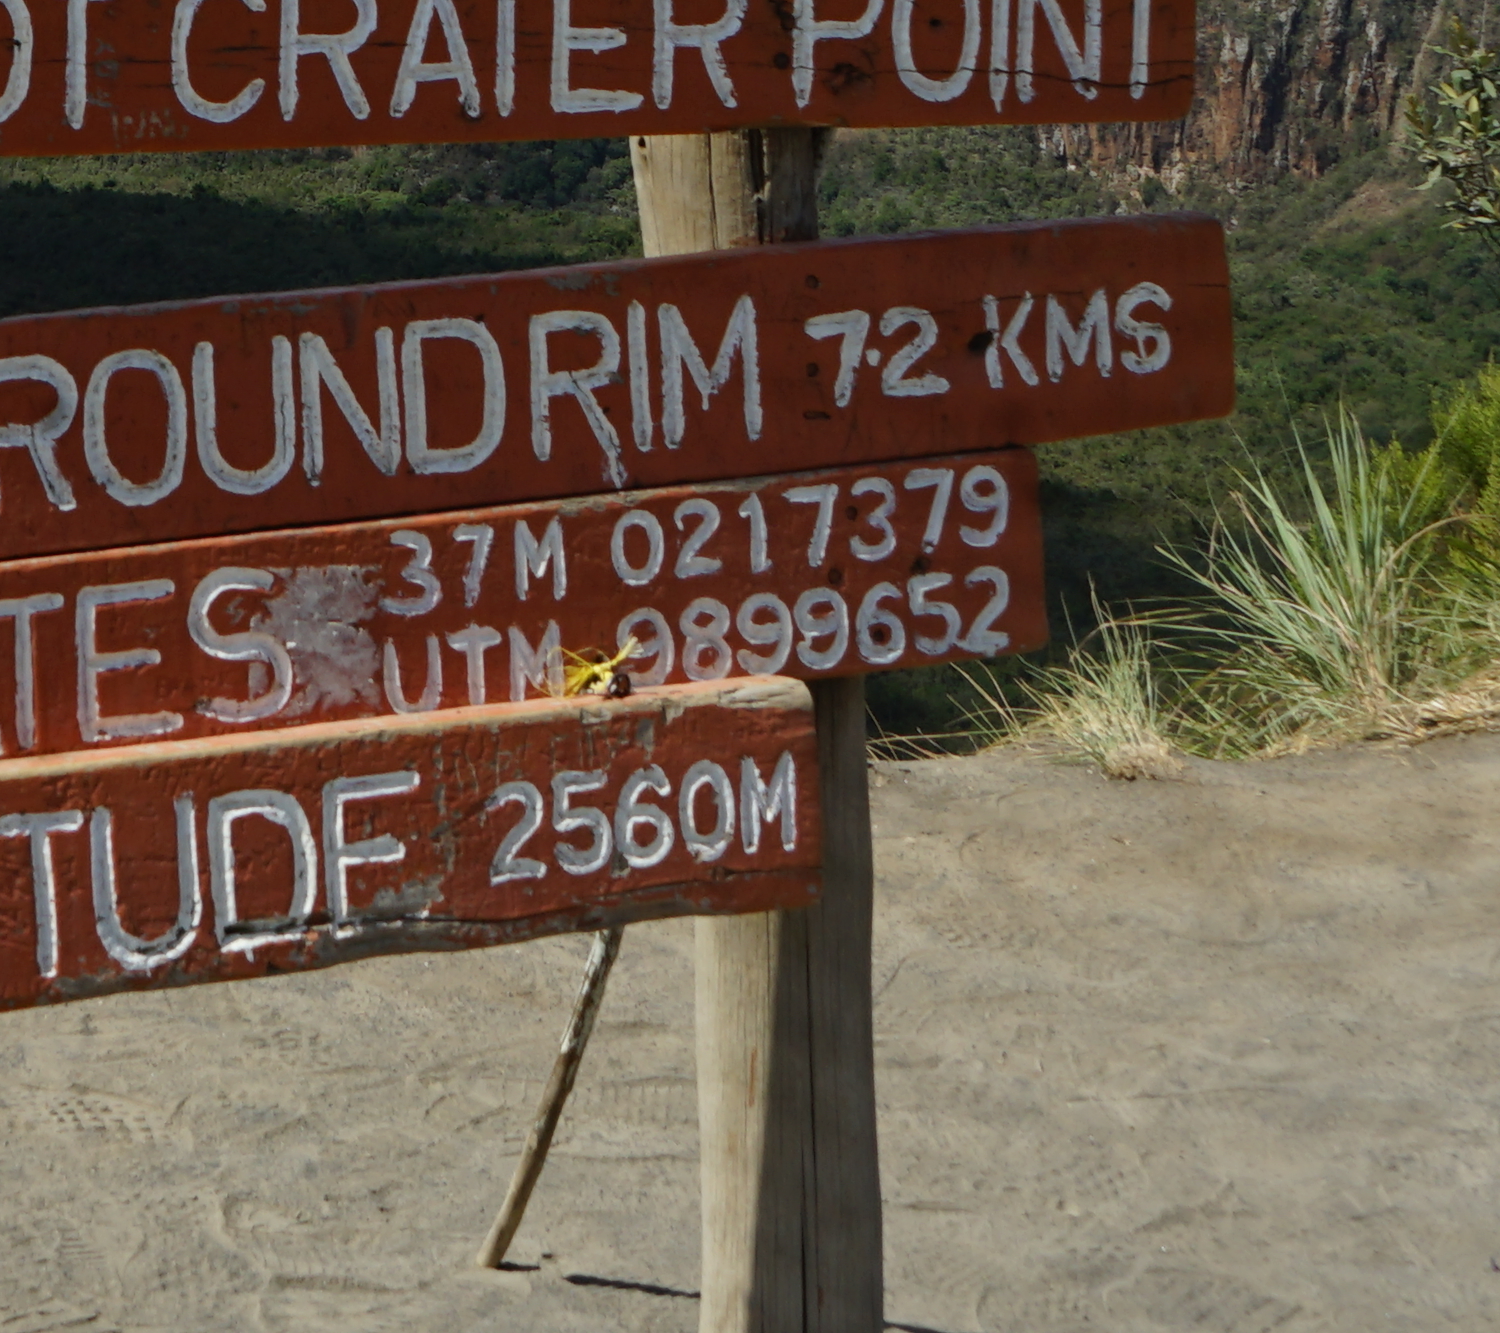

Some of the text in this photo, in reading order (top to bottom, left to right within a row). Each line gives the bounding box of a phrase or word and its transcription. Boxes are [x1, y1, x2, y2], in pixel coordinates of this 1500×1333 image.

[530, 294, 763, 488] RIM
[982, 281, 1172, 389] KMS
[379, 516, 568, 617] 37M
[609, 464, 1010, 587] 0217379
[383, 565, 1010, 714] UTM 9899652
[487, 751, 798, 887] 2560M
